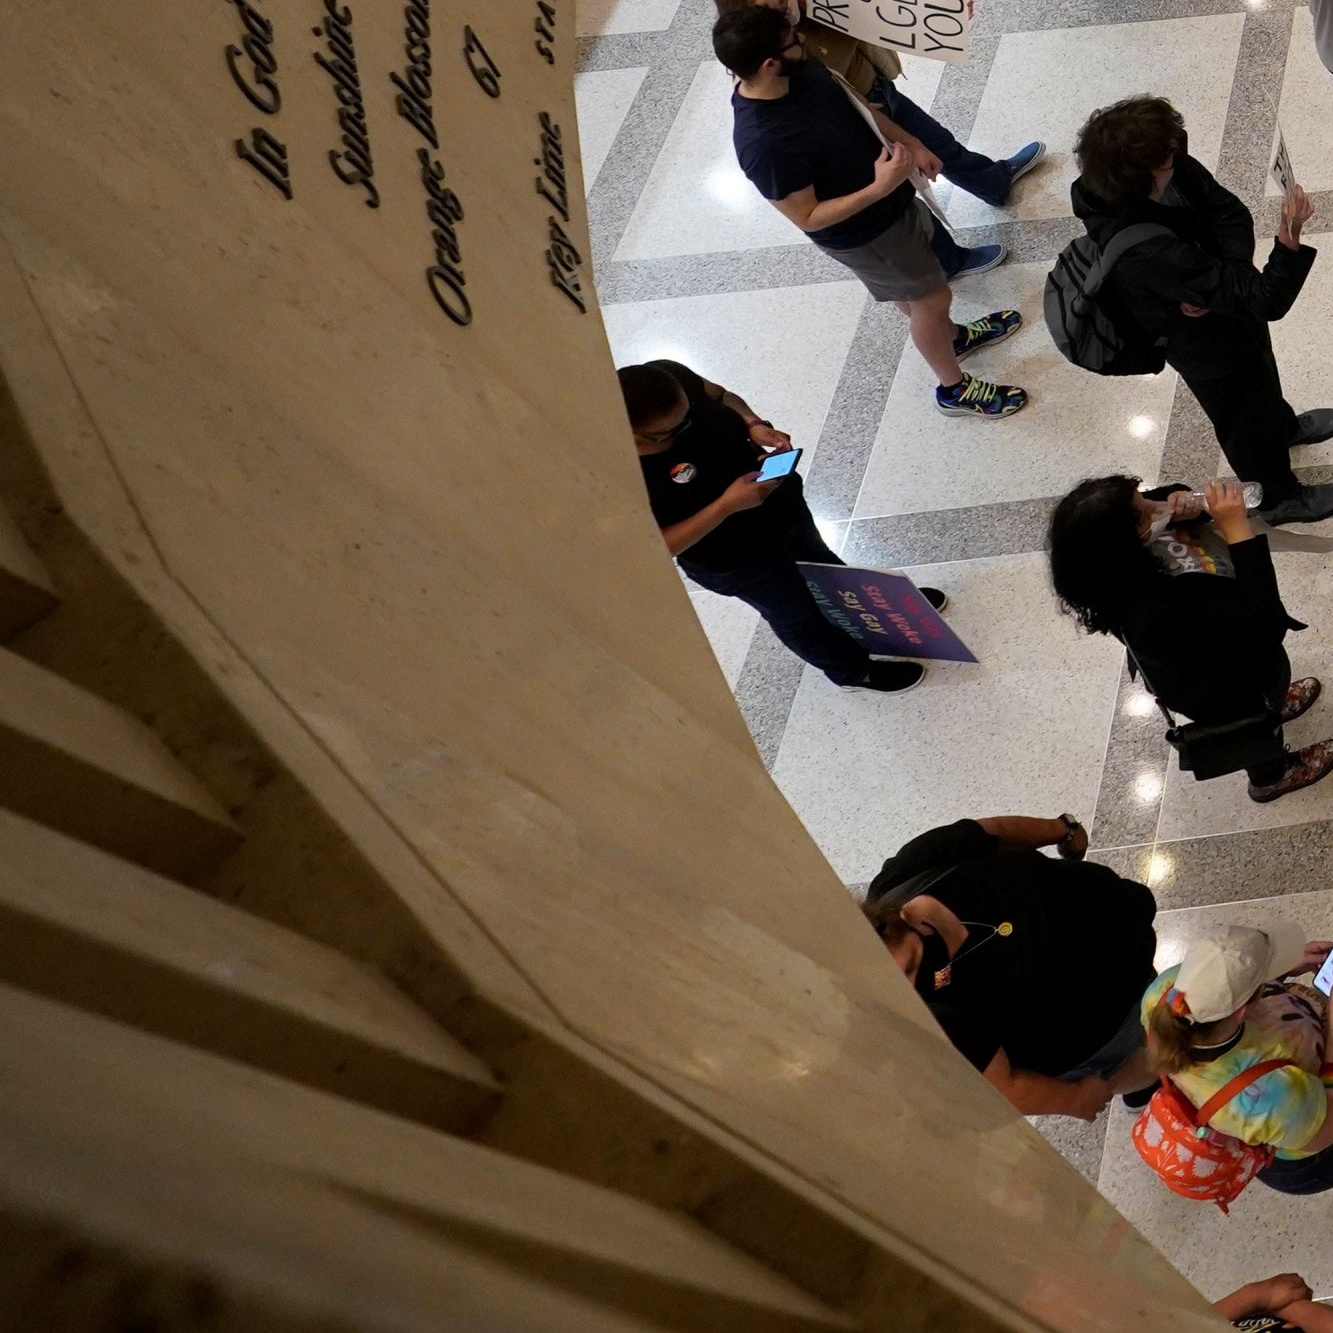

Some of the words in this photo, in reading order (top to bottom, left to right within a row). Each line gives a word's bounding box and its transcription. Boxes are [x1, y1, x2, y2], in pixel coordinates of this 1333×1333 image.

[462, 24, 502, 99] 67
[233, 127, 294, 201] In
[533, 110, 571, 223] Lime
[415, 147, 473, 327] Orange
[544, 214, 588, 316] Key
[859, 613, 888, 635] Gay
